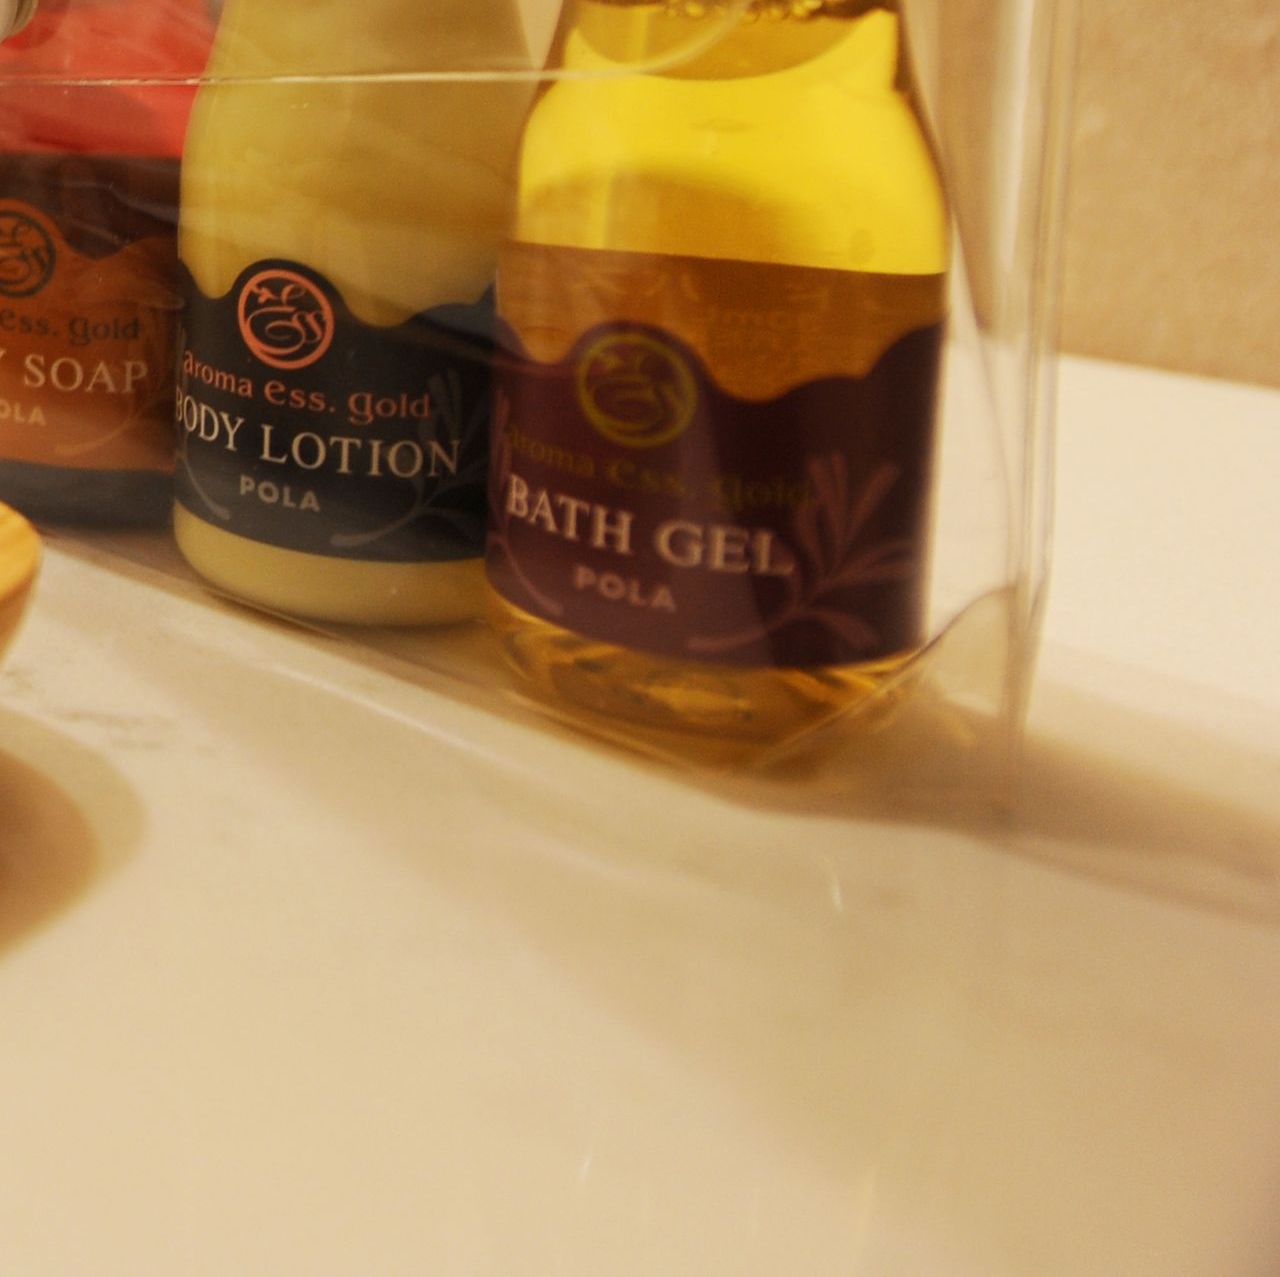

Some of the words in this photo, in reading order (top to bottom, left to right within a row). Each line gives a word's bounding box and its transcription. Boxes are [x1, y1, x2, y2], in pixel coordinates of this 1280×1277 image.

[68, 315, 142, 347] gold
[23, 353, 149, 394] SOAP
[183, 350, 254, 398] aroma
[263, 379, 337, 413] ess.
[347, 391, 431, 426] gold
[176, 386, 245, 452] BODY
[260, 423, 461, 479] LOTION
[239, 474, 321, 513] POLA
[505, 473, 634, 555] BATH
[654, 519, 794, 576] GEL
[573, 565, 676, 613] POLA
